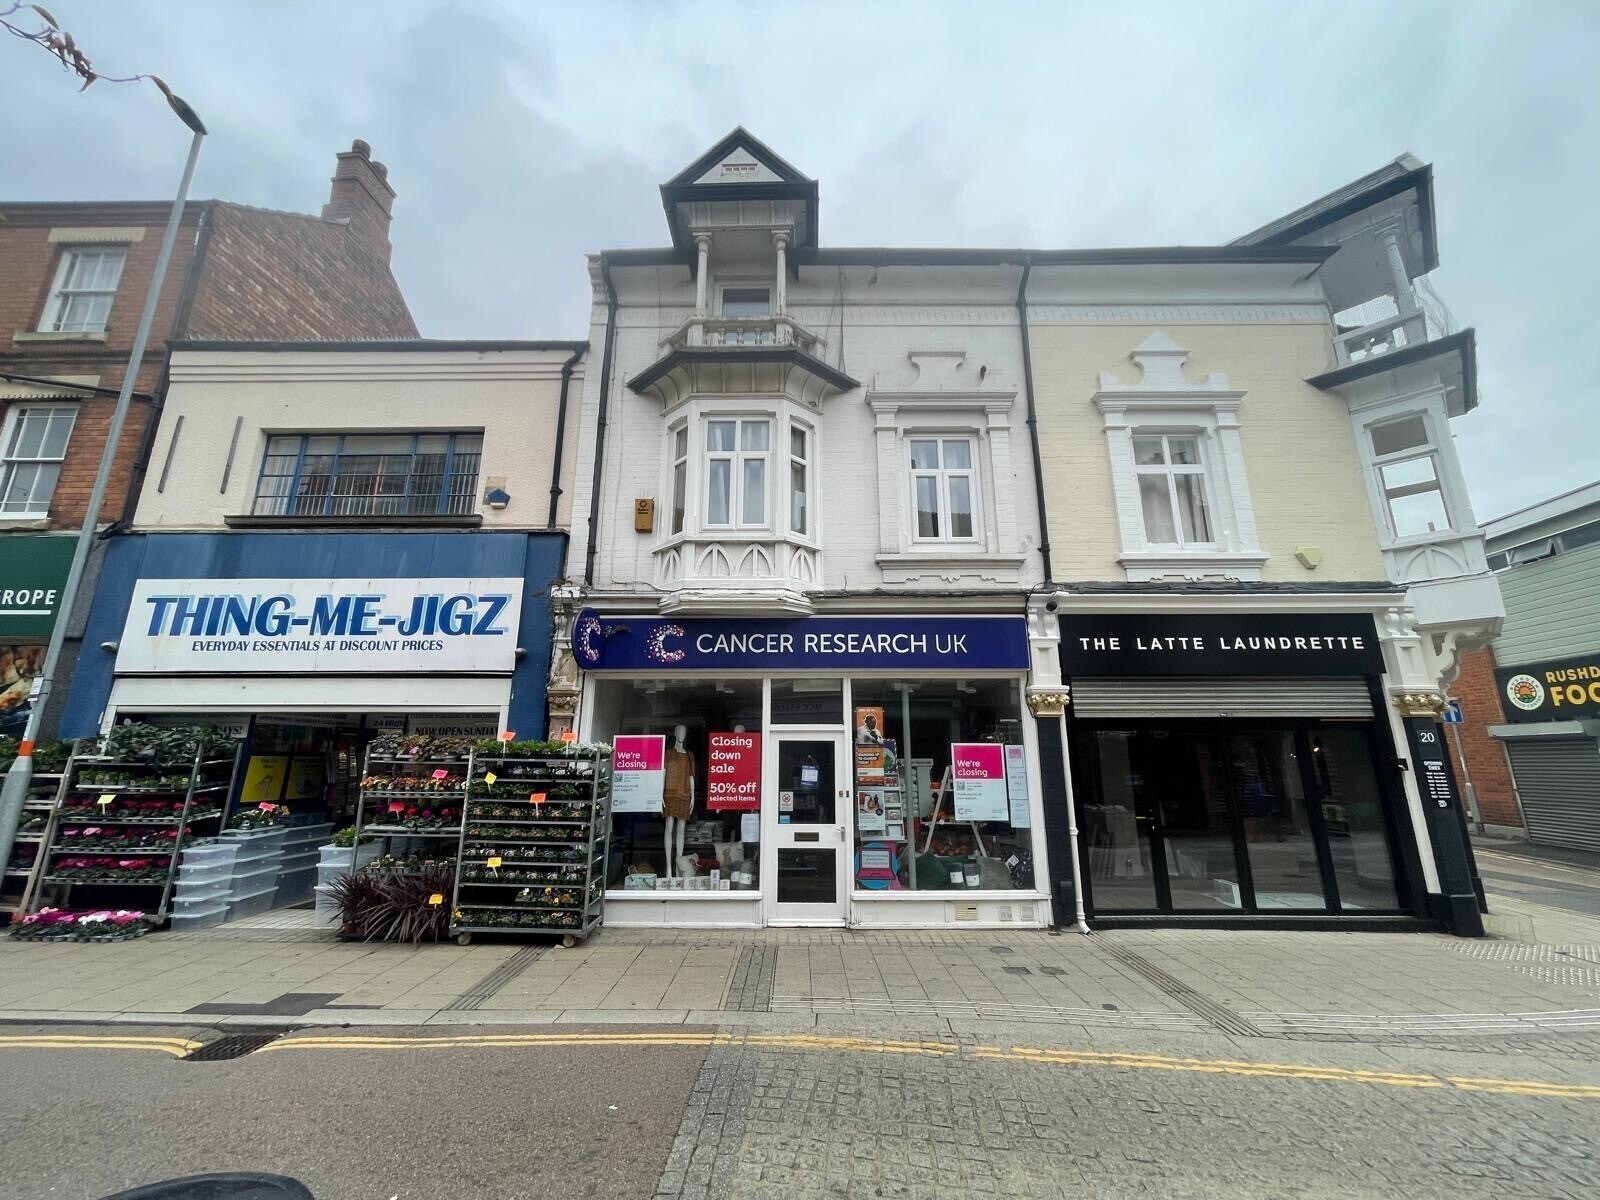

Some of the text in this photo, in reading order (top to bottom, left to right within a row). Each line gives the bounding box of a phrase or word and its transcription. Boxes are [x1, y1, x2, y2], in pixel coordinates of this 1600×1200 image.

[146, 593, 512, 637] THING-ME-JIGZ
[192, 639, 444, 652] EVERYDAY ESSENTIALS AT DISCOUNT PRICES
[696, 633, 968, 654] CANCER RESEARCH UK
[1080, 636, 1365, 650] THE LATTE LAUNDRETTE
[415, 727, 438, 736] NOW
[439, 727, 464, 736] OPEN
[711, 736, 753, 748] Closing
[1420, 732, 1435, 743] 20
[617, 752, 641, 760] We're
[711, 750, 741, 760] down
[616, 761, 647, 770] closing
[710, 763, 736, 774] sale
[956, 760, 981, 768] We're
[957, 768, 988, 778] closing
[710, 782, 757, 794] 50% off
